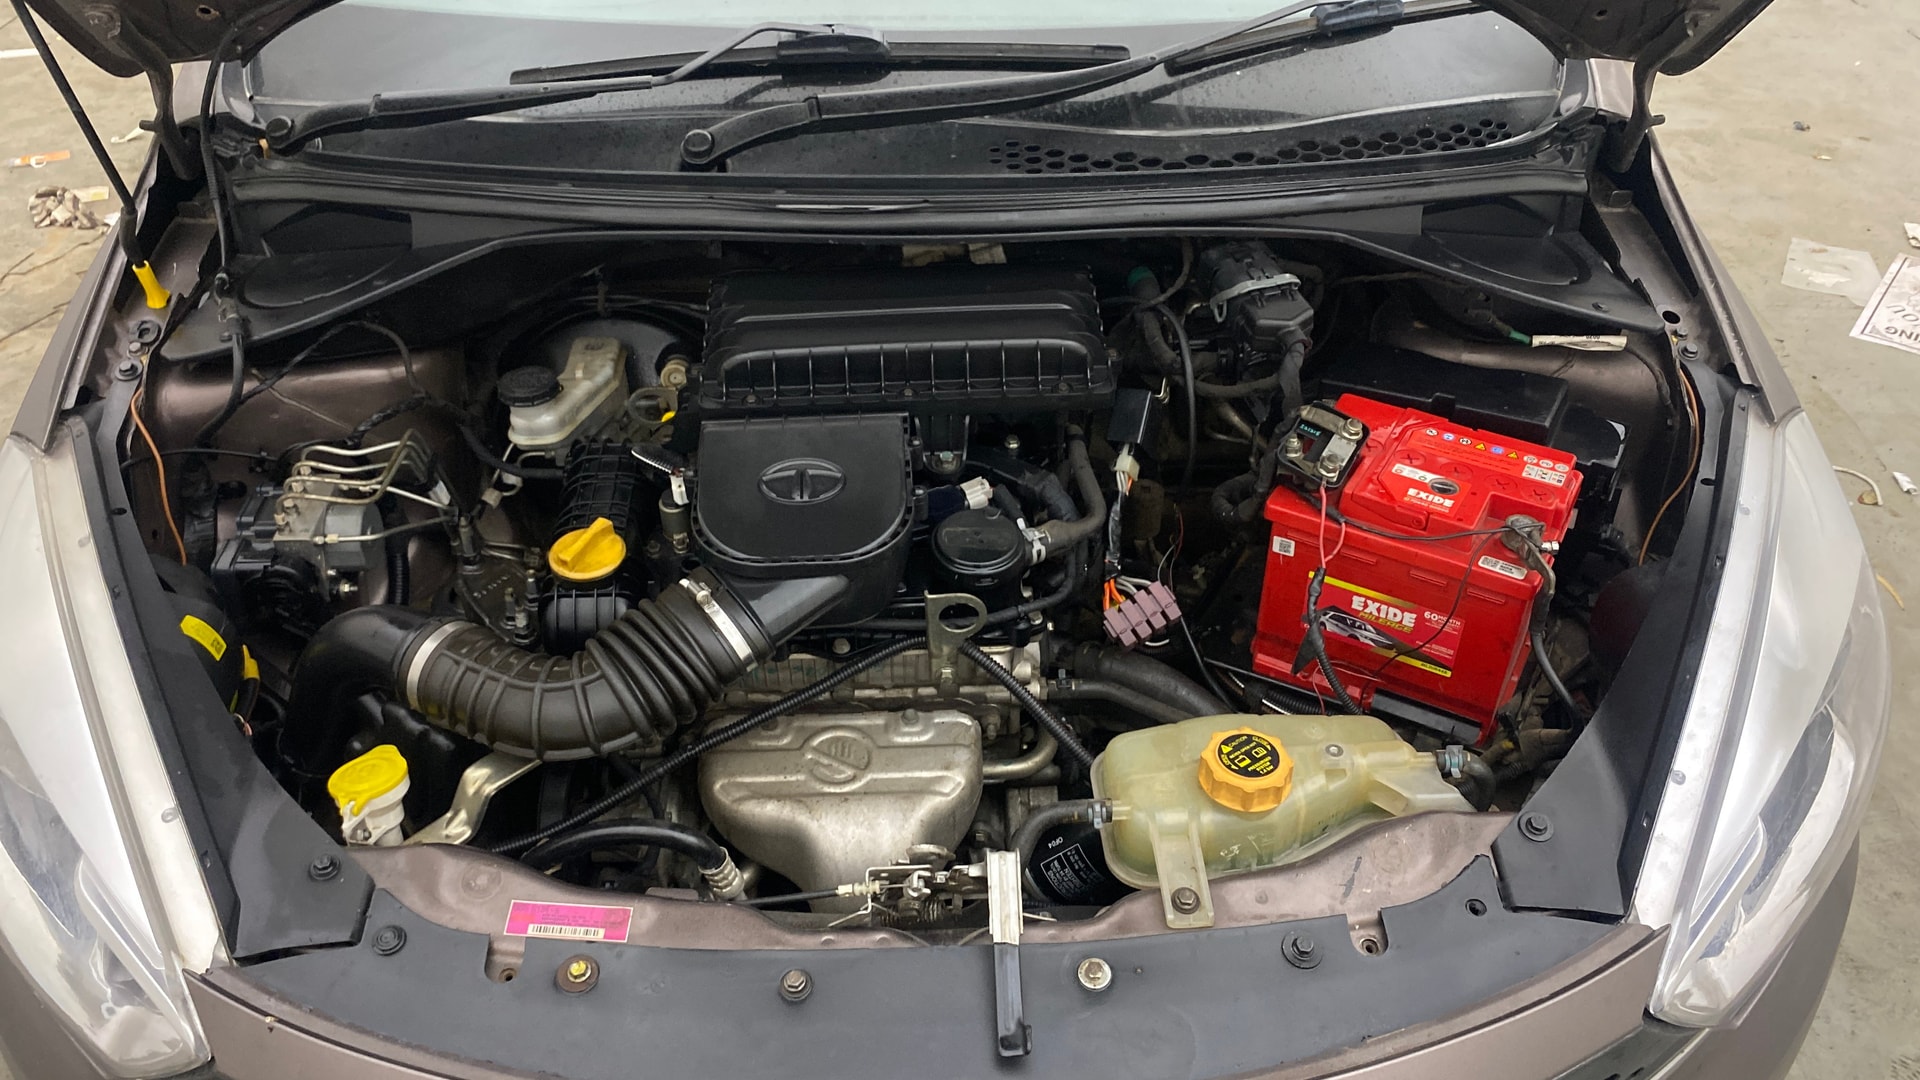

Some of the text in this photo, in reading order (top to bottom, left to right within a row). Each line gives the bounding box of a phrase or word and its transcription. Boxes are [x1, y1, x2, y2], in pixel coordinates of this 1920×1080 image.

[1886, 304, 1920, 327] OU
[1885, 326, 1920, 343] ING
[1407, 487, 1455, 507] EXIDE
[1351, 595, 1417, 627] EXIDE
[1424, 611, 1438, 621] 60
[1358, 611, 1413, 633] MILEAGE
